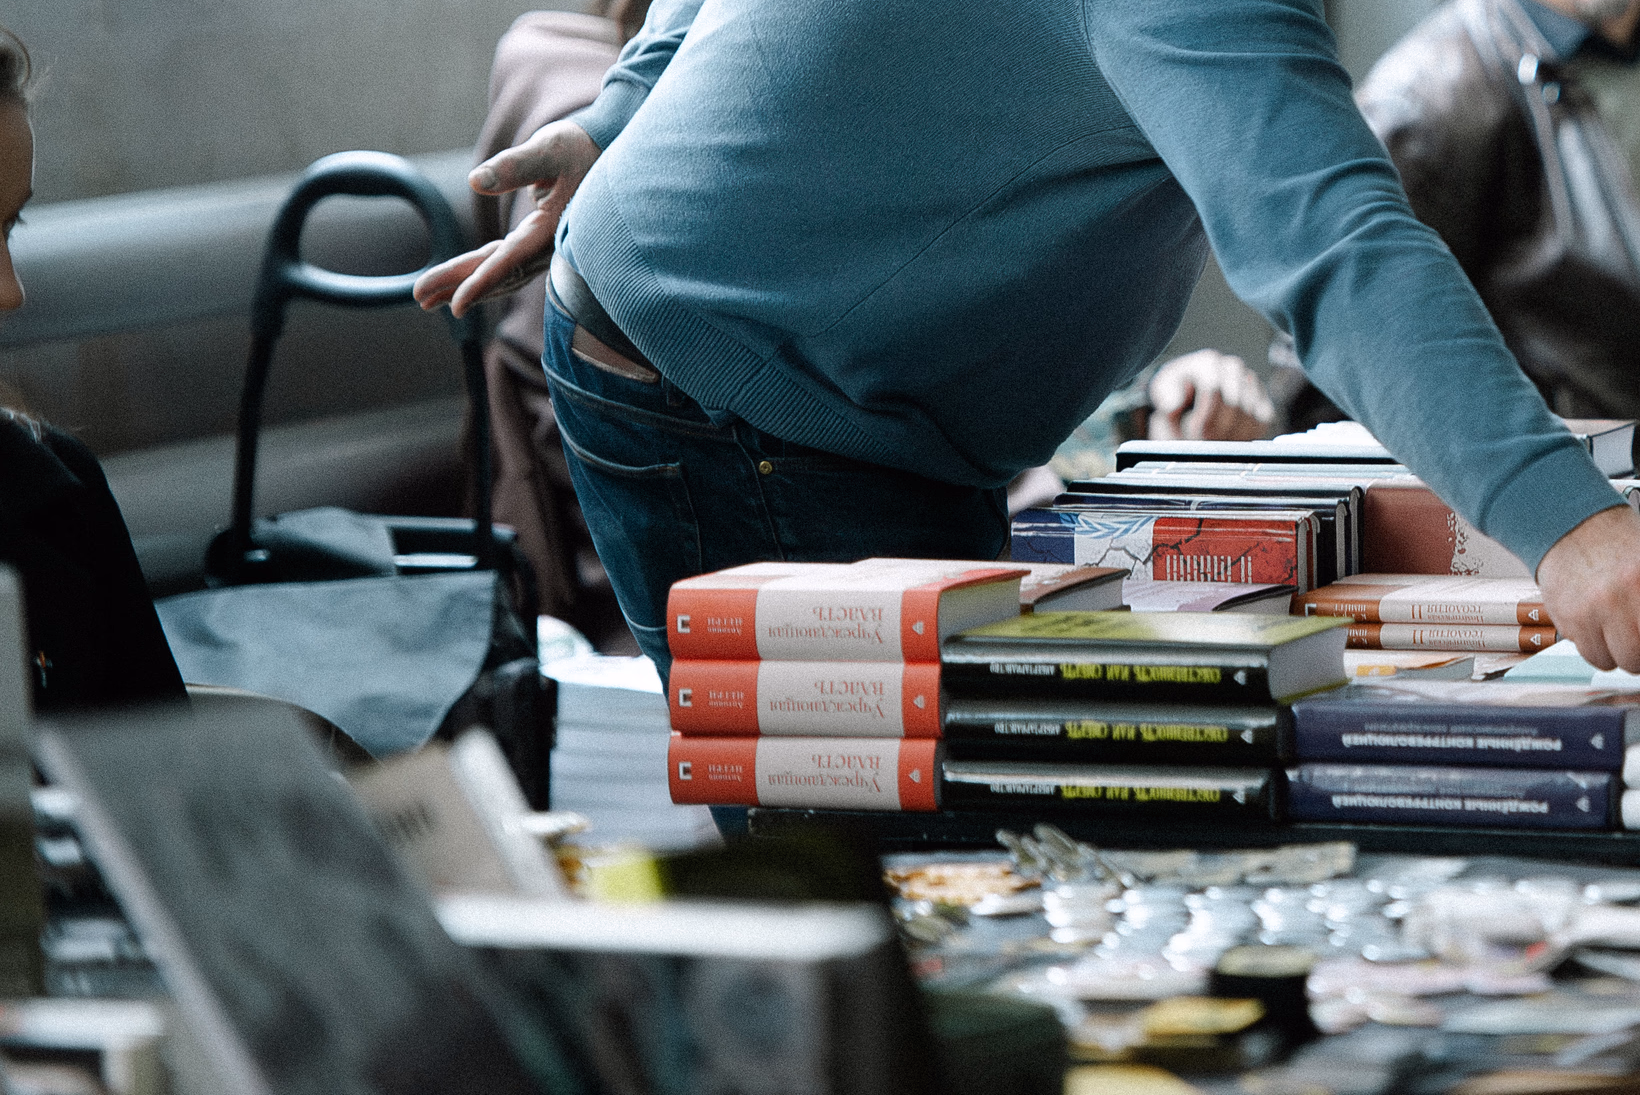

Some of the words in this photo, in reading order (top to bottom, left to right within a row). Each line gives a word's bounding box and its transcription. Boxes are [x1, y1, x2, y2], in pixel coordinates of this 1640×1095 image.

[813, 607, 883, 621] ВЛАСТЬ
[768, 623, 883, 644] Учреждающая
[814, 681, 884, 696] ВЛАСТЬ
[770, 697, 884, 718] Учреждающая
[812, 754, 880, 769] ВЛАСТЬ
[768, 771, 881, 792] Учреждающая
